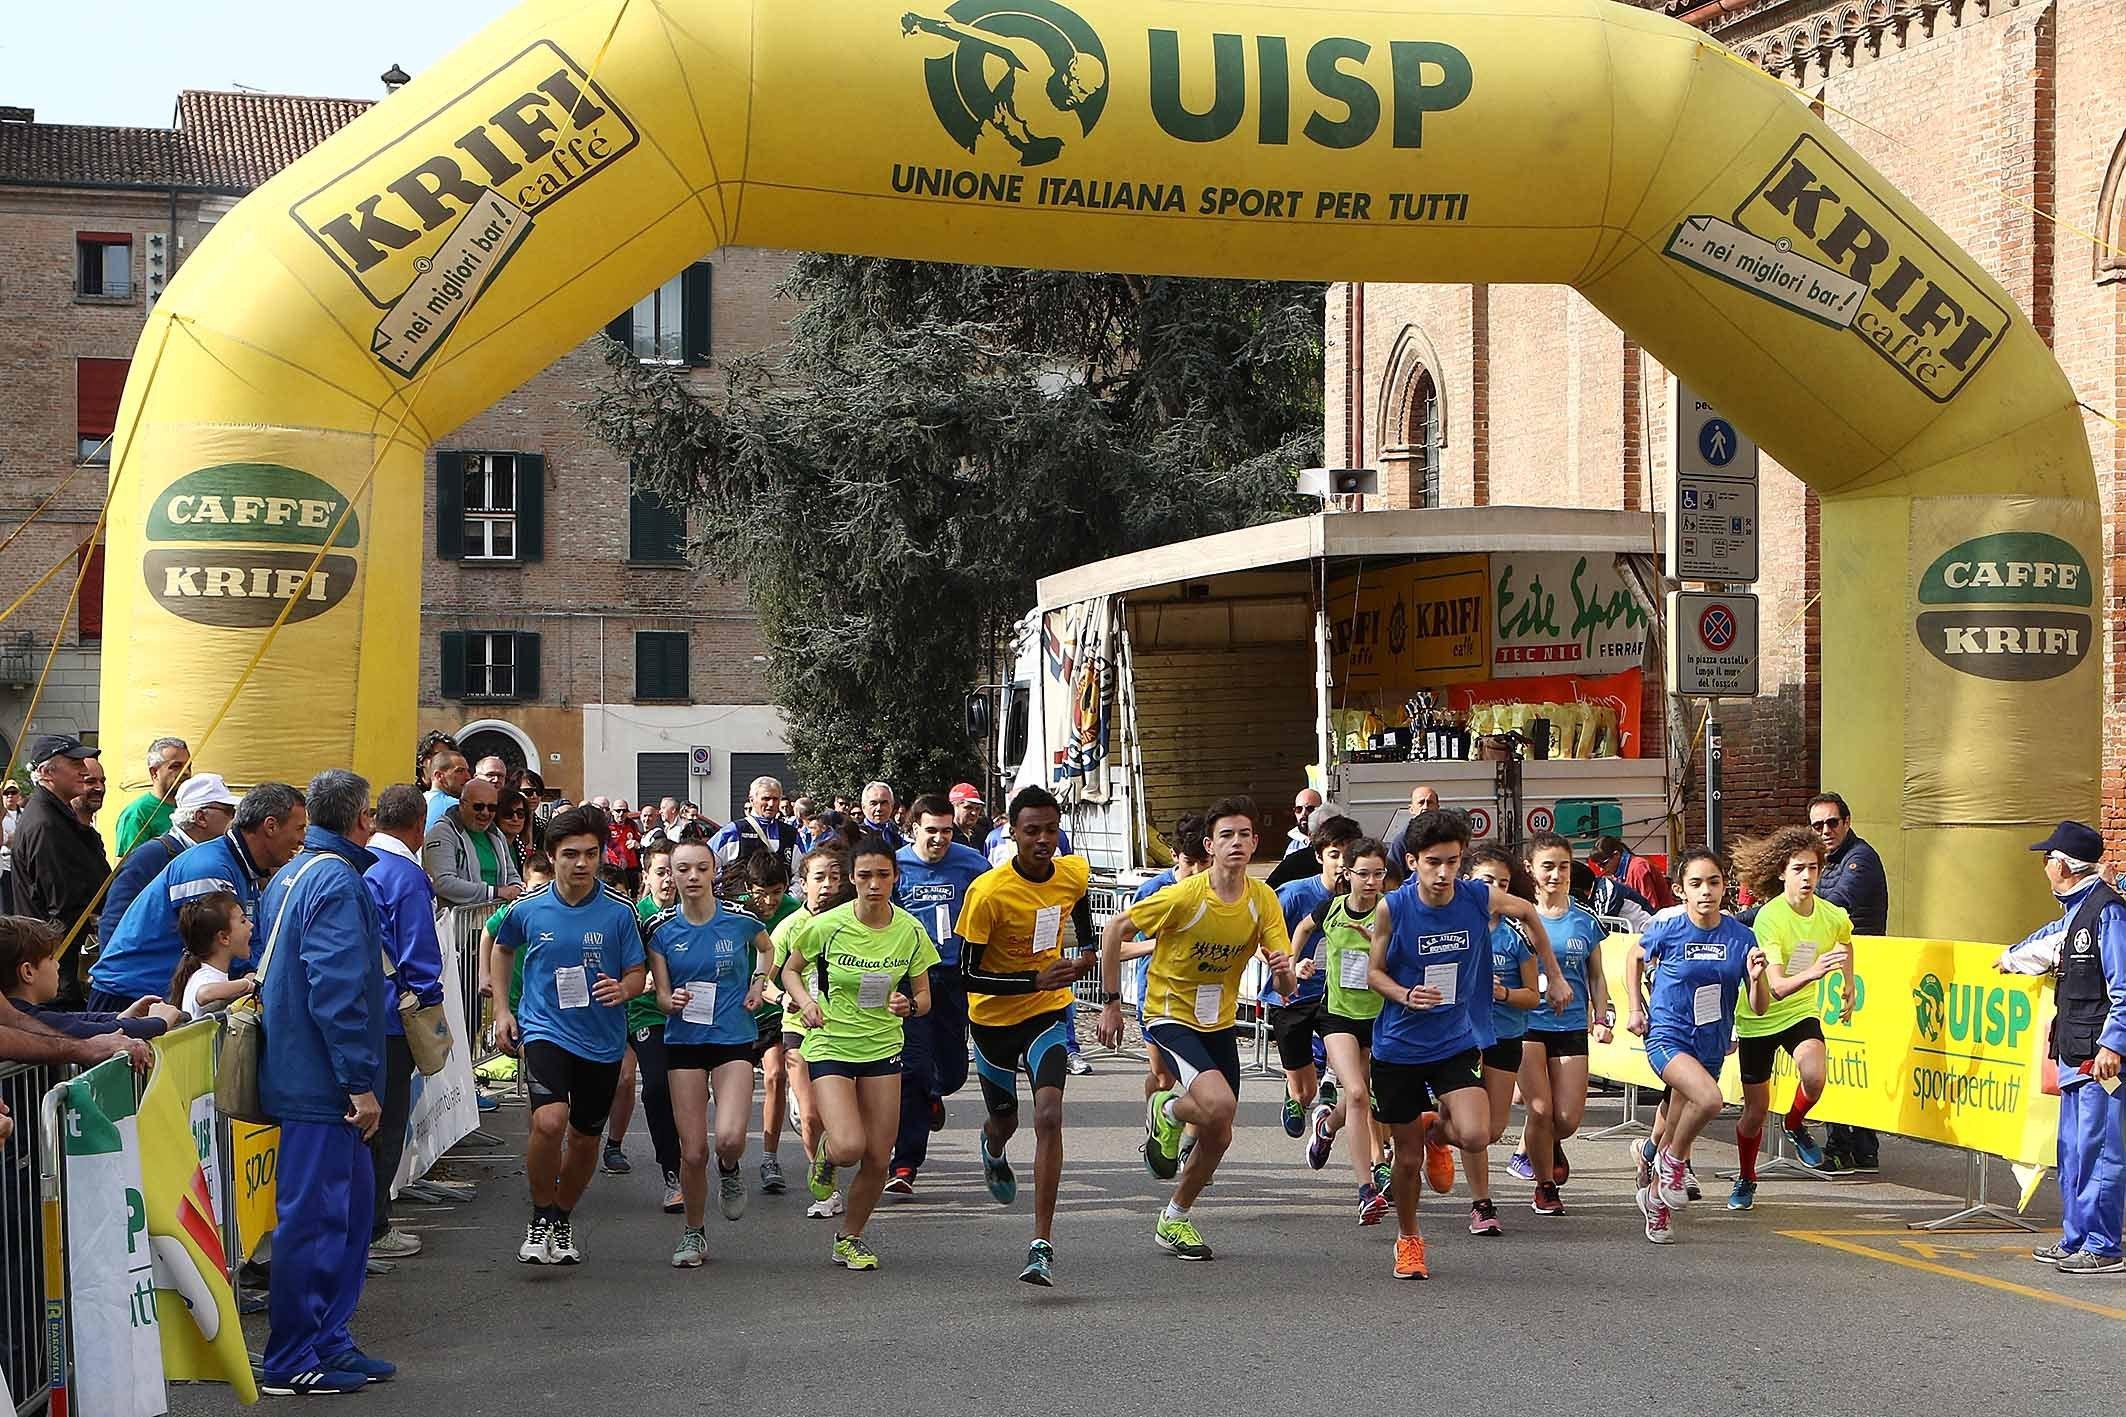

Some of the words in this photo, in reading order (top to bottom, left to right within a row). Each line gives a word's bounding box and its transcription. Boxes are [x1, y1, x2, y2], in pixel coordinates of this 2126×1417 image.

[1148, 28, 1474, 149] UISP
[318, 69, 606, 274] KRIFI
[517, 128, 612, 211] caffé
[891, 163, 1024, 203] UNIONE
[1038, 176, 1186, 213] ITALIANA
[1199, 186, 1304, 219] SPORT
[1316, 190, 1371, 221] PER
[1388, 192, 1470, 222] TUTTI
[1702, 240, 1735, 263] nei
[1736, 255, 1806, 293] migliori
[1763, 158, 1993, 373] KRIFI
[403, 312, 433, 344] nei
[426, 249, 482, 315] migliori
[1857, 311, 1945, 386] caffé
[163, 566, 329, 601] KRIFI
[1416, 597, 1480, 639] KRIFI
[1943, 627, 2079, 656] KRIFI
[1696, 656, 1717, 664] piazza
[1720, 656, 1748, 664] castello
[1699, 679, 1709, 688] del
[1472, 817, 1483, 829] 70
[1534, 816, 1547, 828] 80
[838, 954, 880, 968] Atletica
[1949, 982, 2031, 1048] UISP
